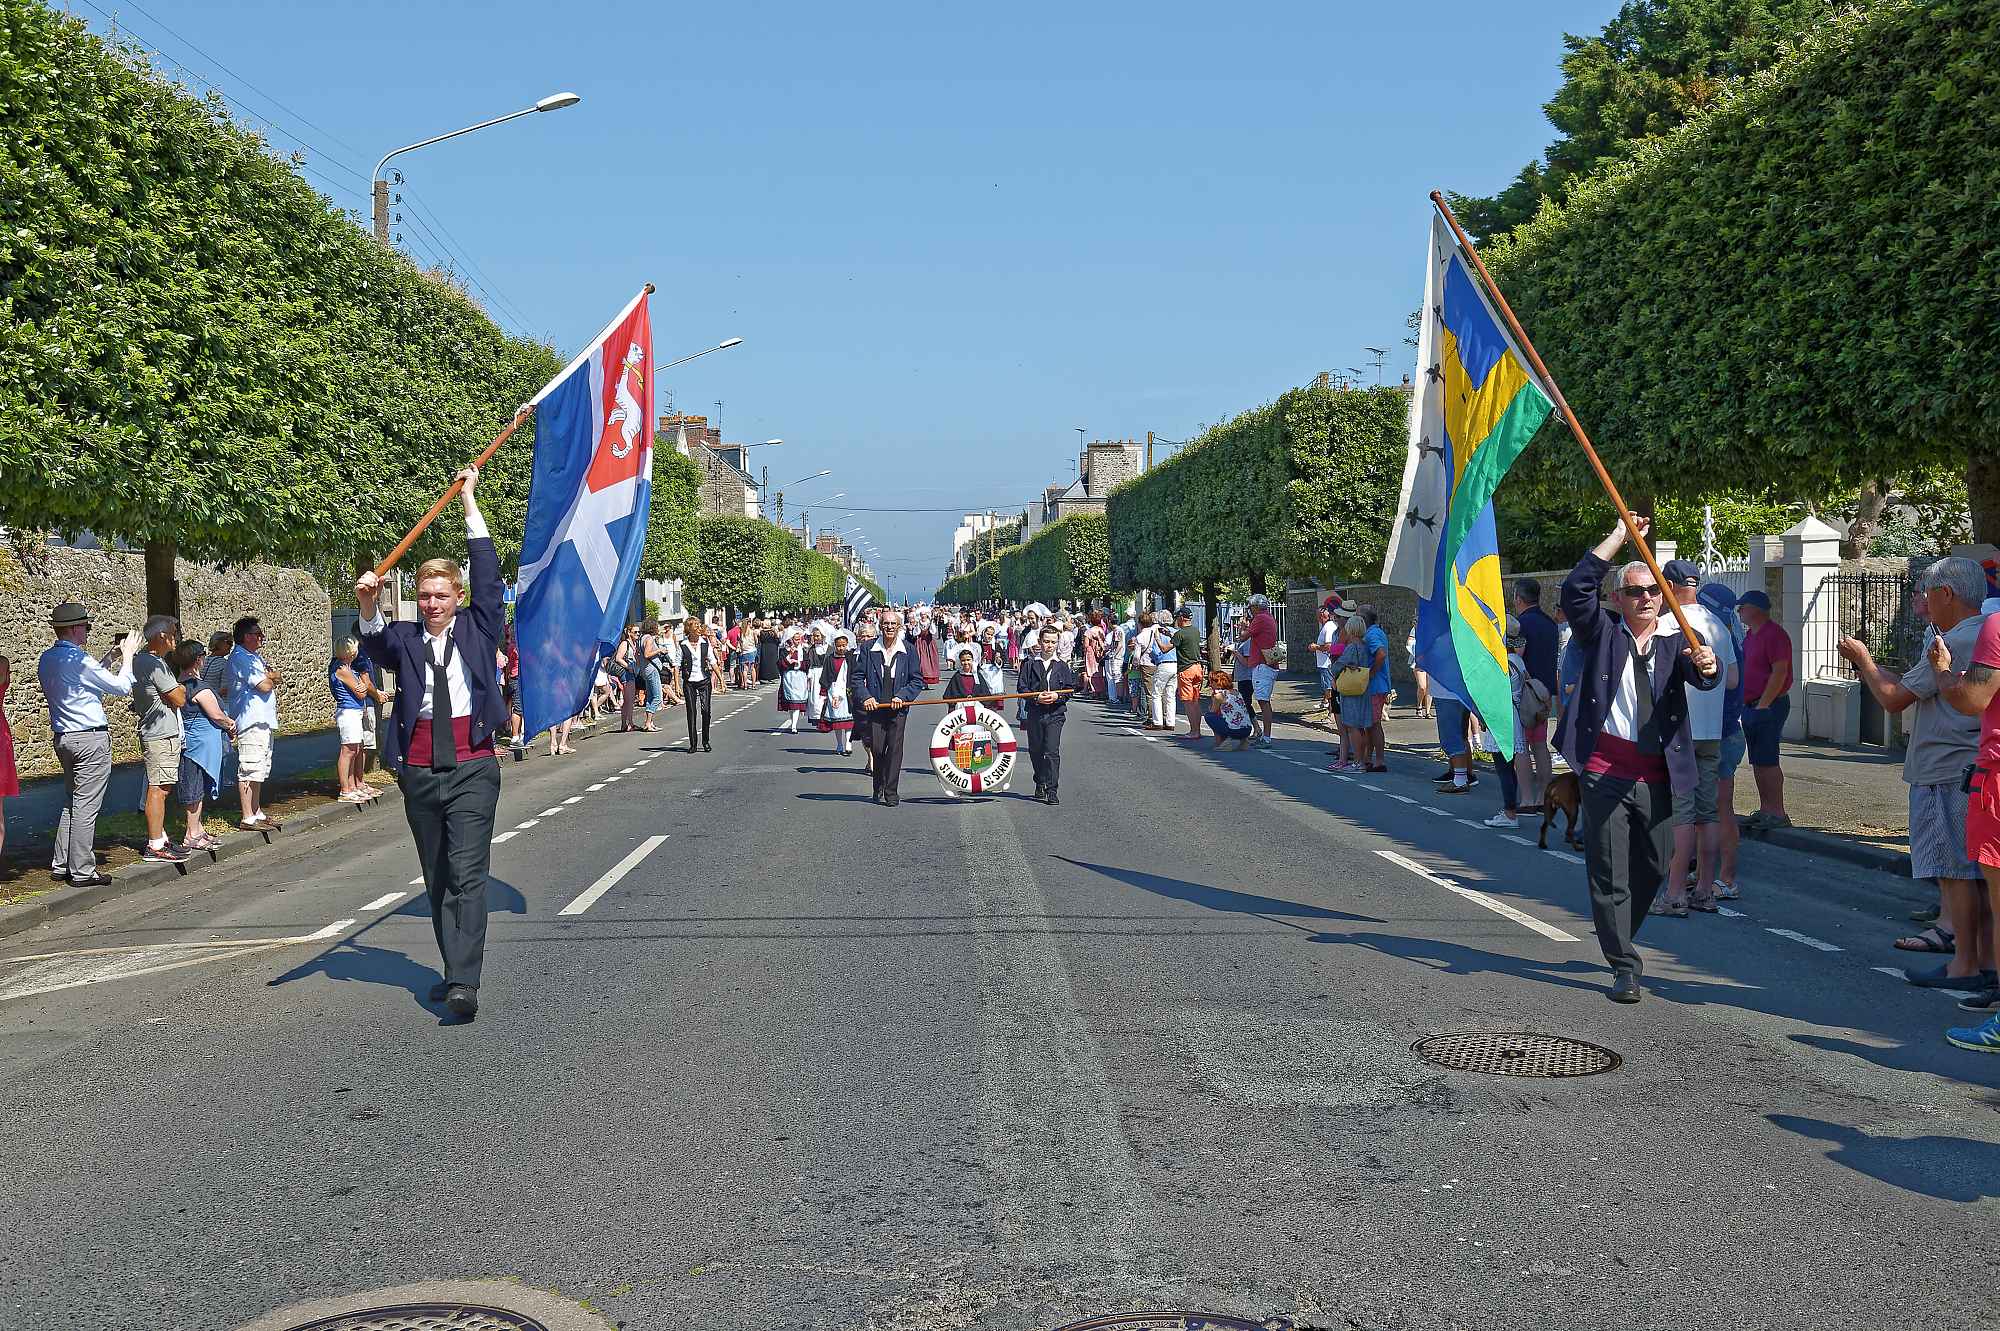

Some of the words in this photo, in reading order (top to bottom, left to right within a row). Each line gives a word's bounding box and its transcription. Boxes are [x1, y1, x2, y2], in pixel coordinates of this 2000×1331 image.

[941, 714, 965, 736] GWIK
[978, 713, 1003, 731] ALET
[992, 754, 1012, 780] SERVAN
[946, 771, 968, 788] MALO
